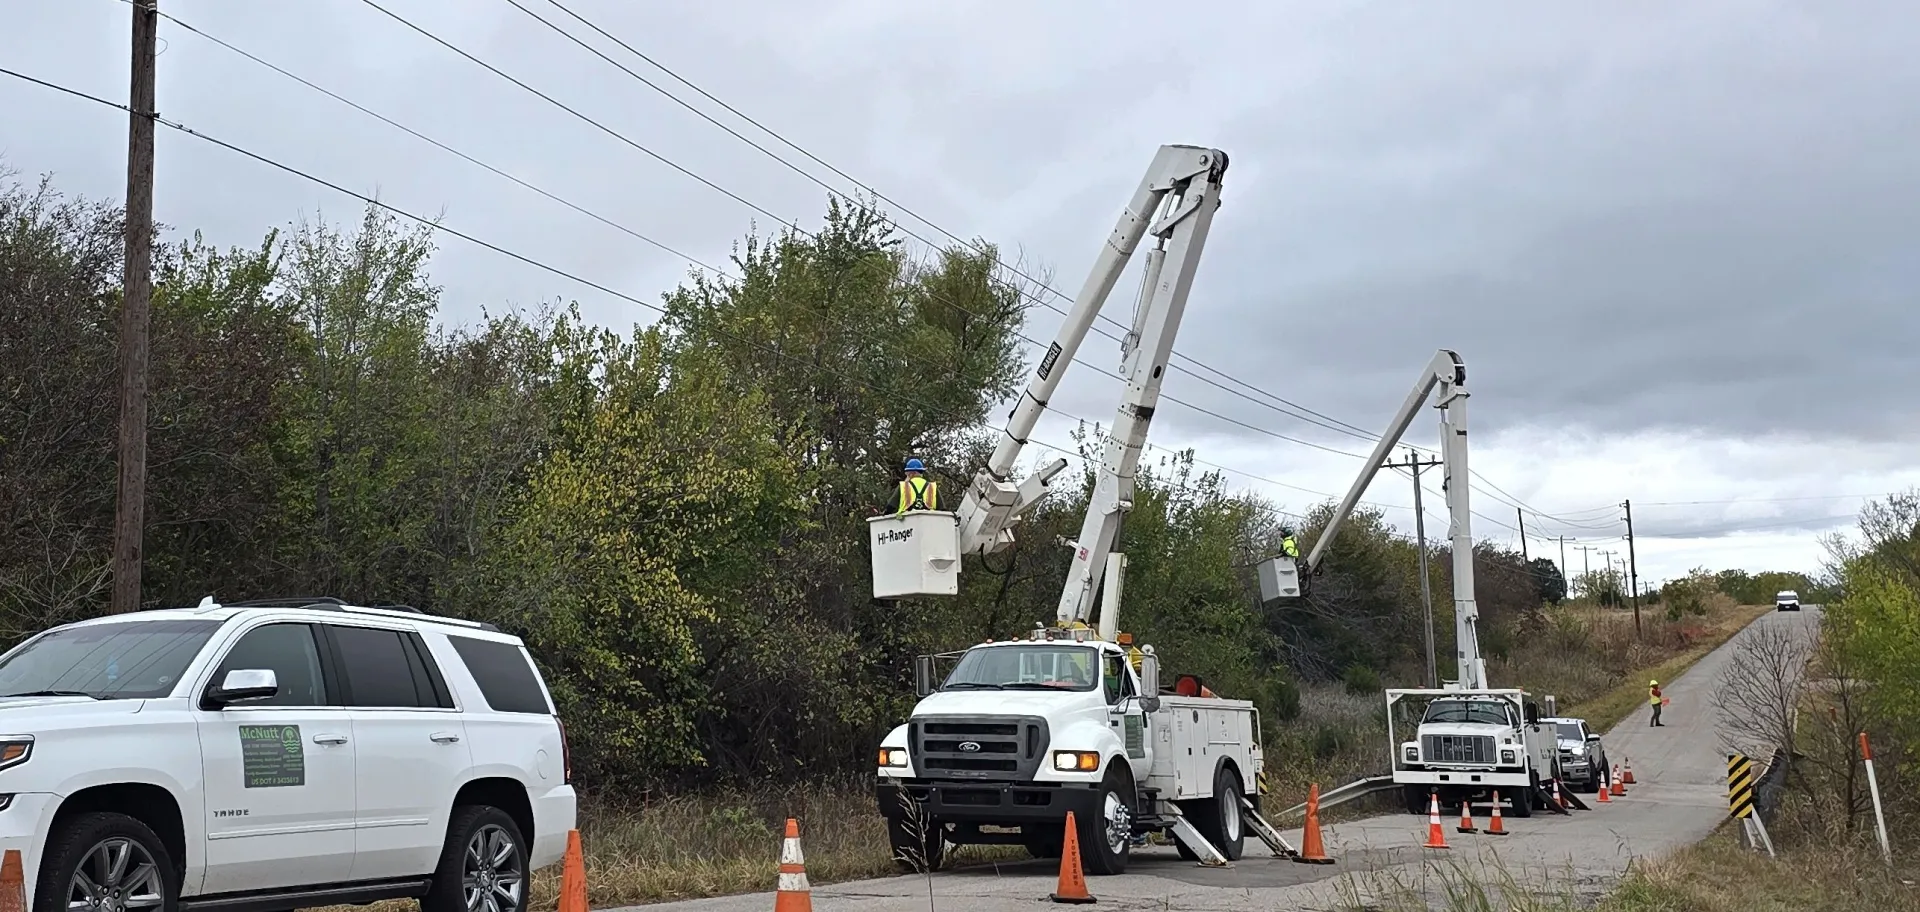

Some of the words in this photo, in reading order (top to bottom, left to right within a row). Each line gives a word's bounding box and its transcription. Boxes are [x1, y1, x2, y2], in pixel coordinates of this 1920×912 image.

[1038, 343, 1061, 379] HI-RANGER
[240, 727, 280, 739] McNutt
[259, 777, 272, 785] DOT
[213, 809, 250, 817] TAHOE
